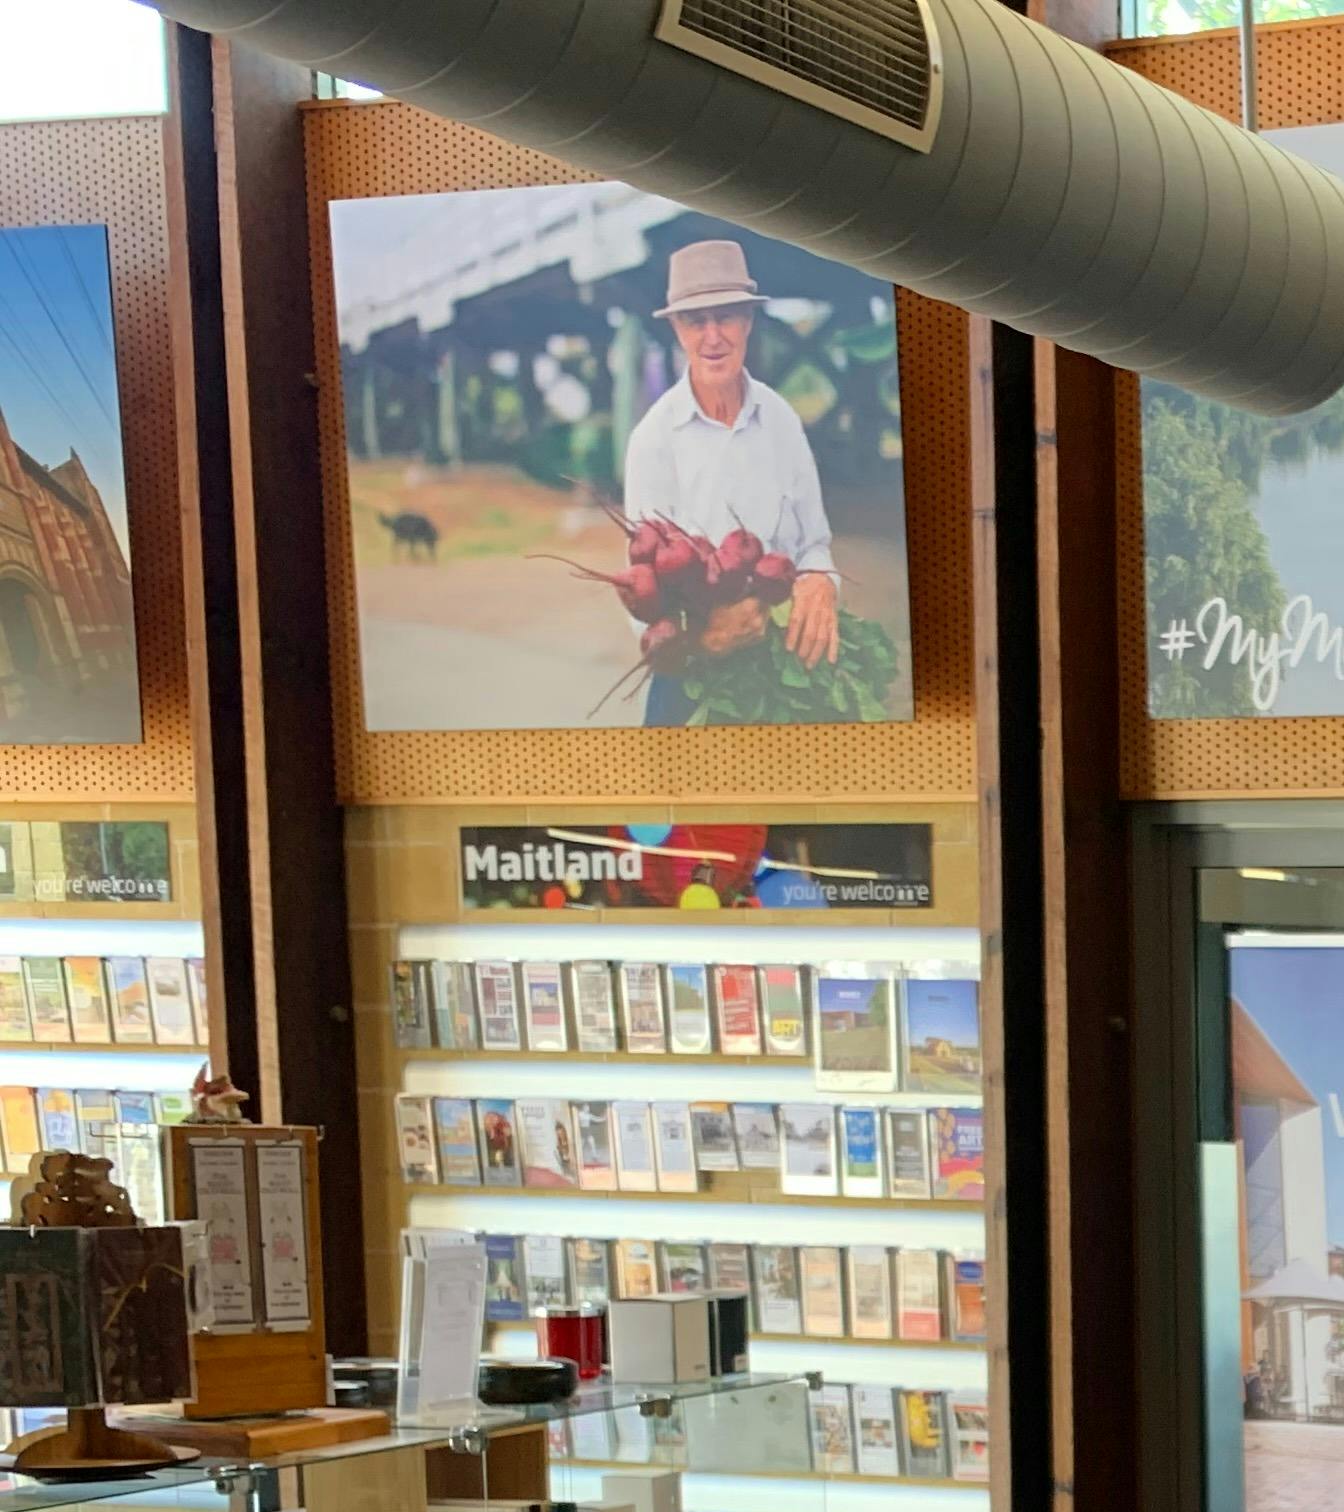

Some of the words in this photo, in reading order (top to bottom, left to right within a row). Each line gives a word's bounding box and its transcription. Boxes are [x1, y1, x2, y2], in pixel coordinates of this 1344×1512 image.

[464, 843, 643, 881] Maitland
[783, 880, 837, 905] you're
[840, 879, 930, 902] welcome
